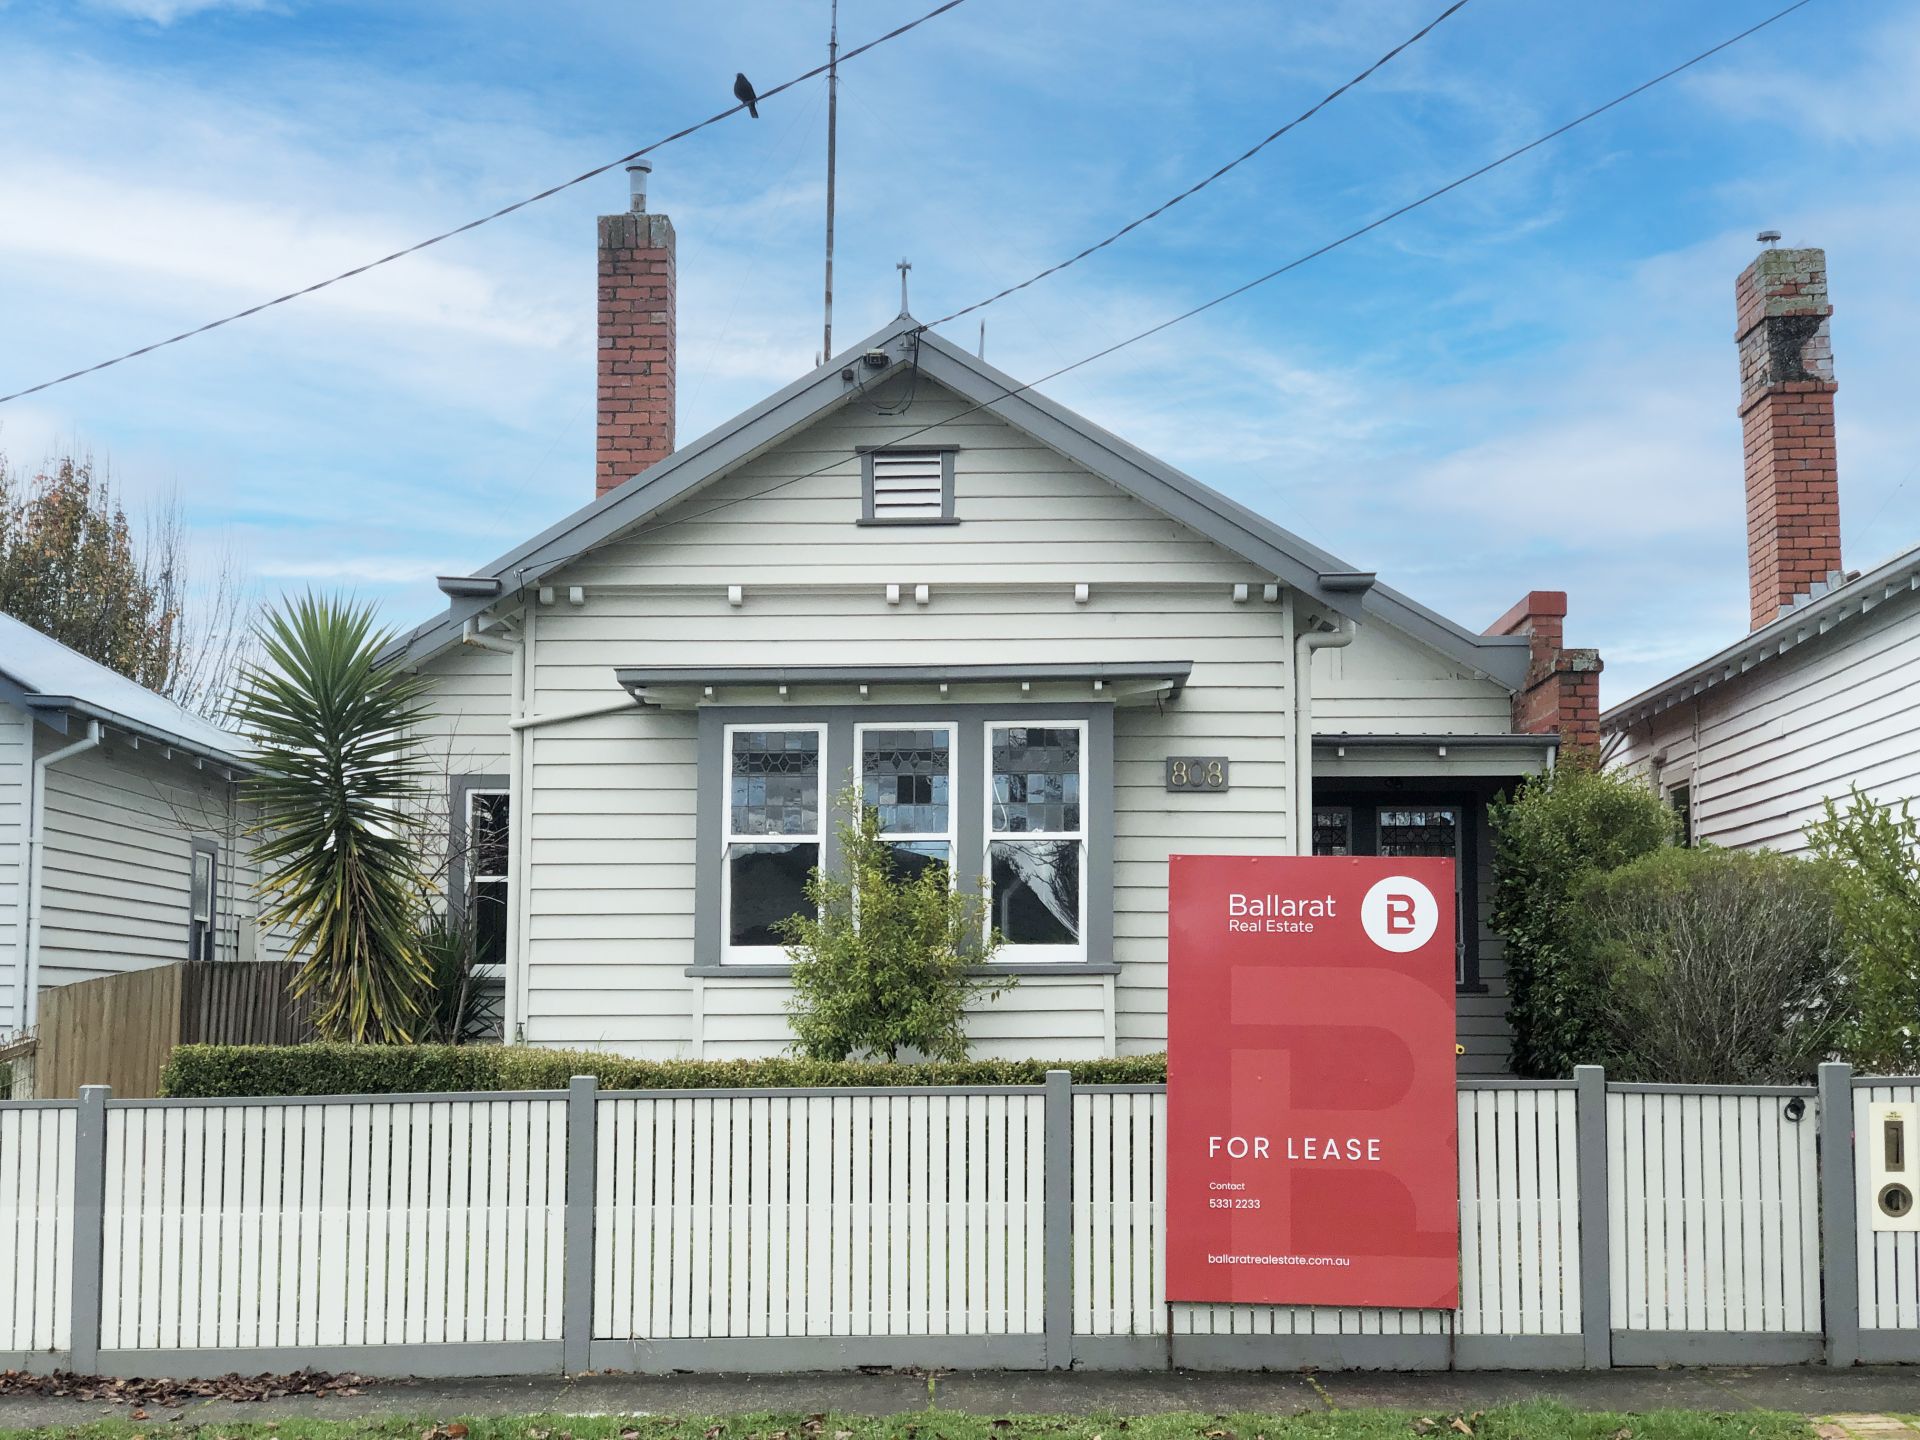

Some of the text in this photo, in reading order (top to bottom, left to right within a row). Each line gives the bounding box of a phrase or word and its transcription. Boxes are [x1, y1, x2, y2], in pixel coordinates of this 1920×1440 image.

[1172, 761, 1222, 786] 808
[1229, 893, 1336, 917] Ballarat
[1229, 919, 1314, 933] Real Estate
[1209, 1136, 1381, 1160] FOR LEASE
[1209, 1182, 1245, 1190] Contact
[1209, 1199, 1261, 1209] 5331 2233
[1208, 1253, 1350, 1265] ballaratrealestate.com.au
